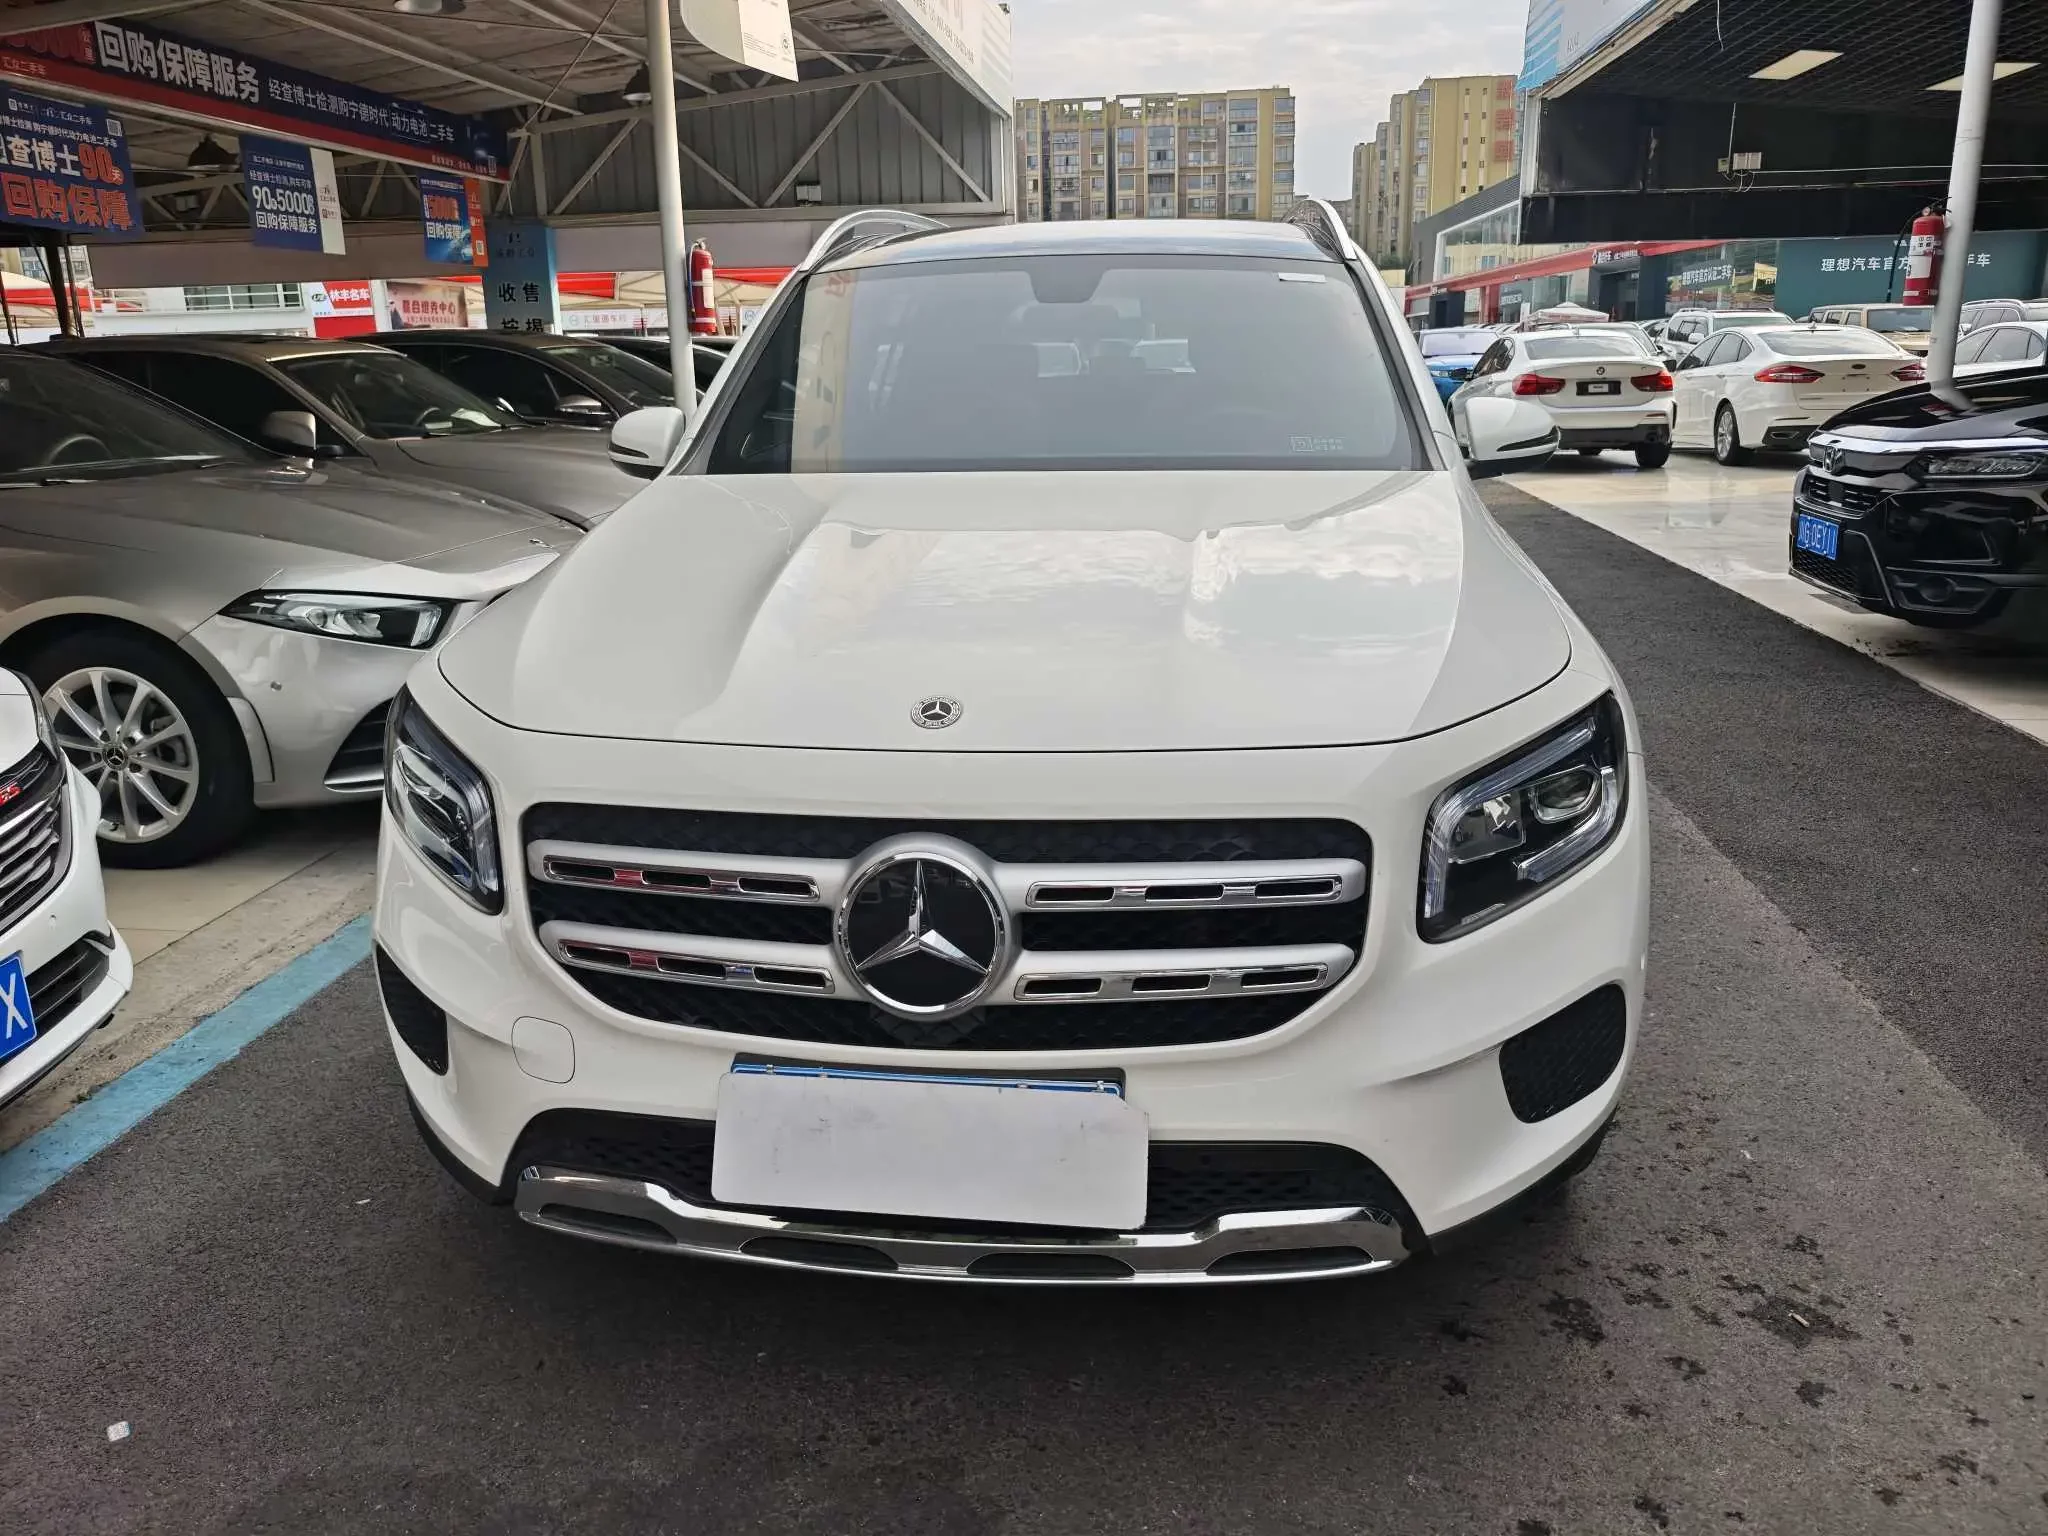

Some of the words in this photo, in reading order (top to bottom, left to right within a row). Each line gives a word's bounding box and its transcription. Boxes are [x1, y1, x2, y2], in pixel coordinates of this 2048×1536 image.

[95, 20, 259, 103] 回购保障服务
[1, 172, 132, 231] 回购保障
[256, 211, 317, 234] 回购保障服务
[499, 282, 540, 303] 收售
